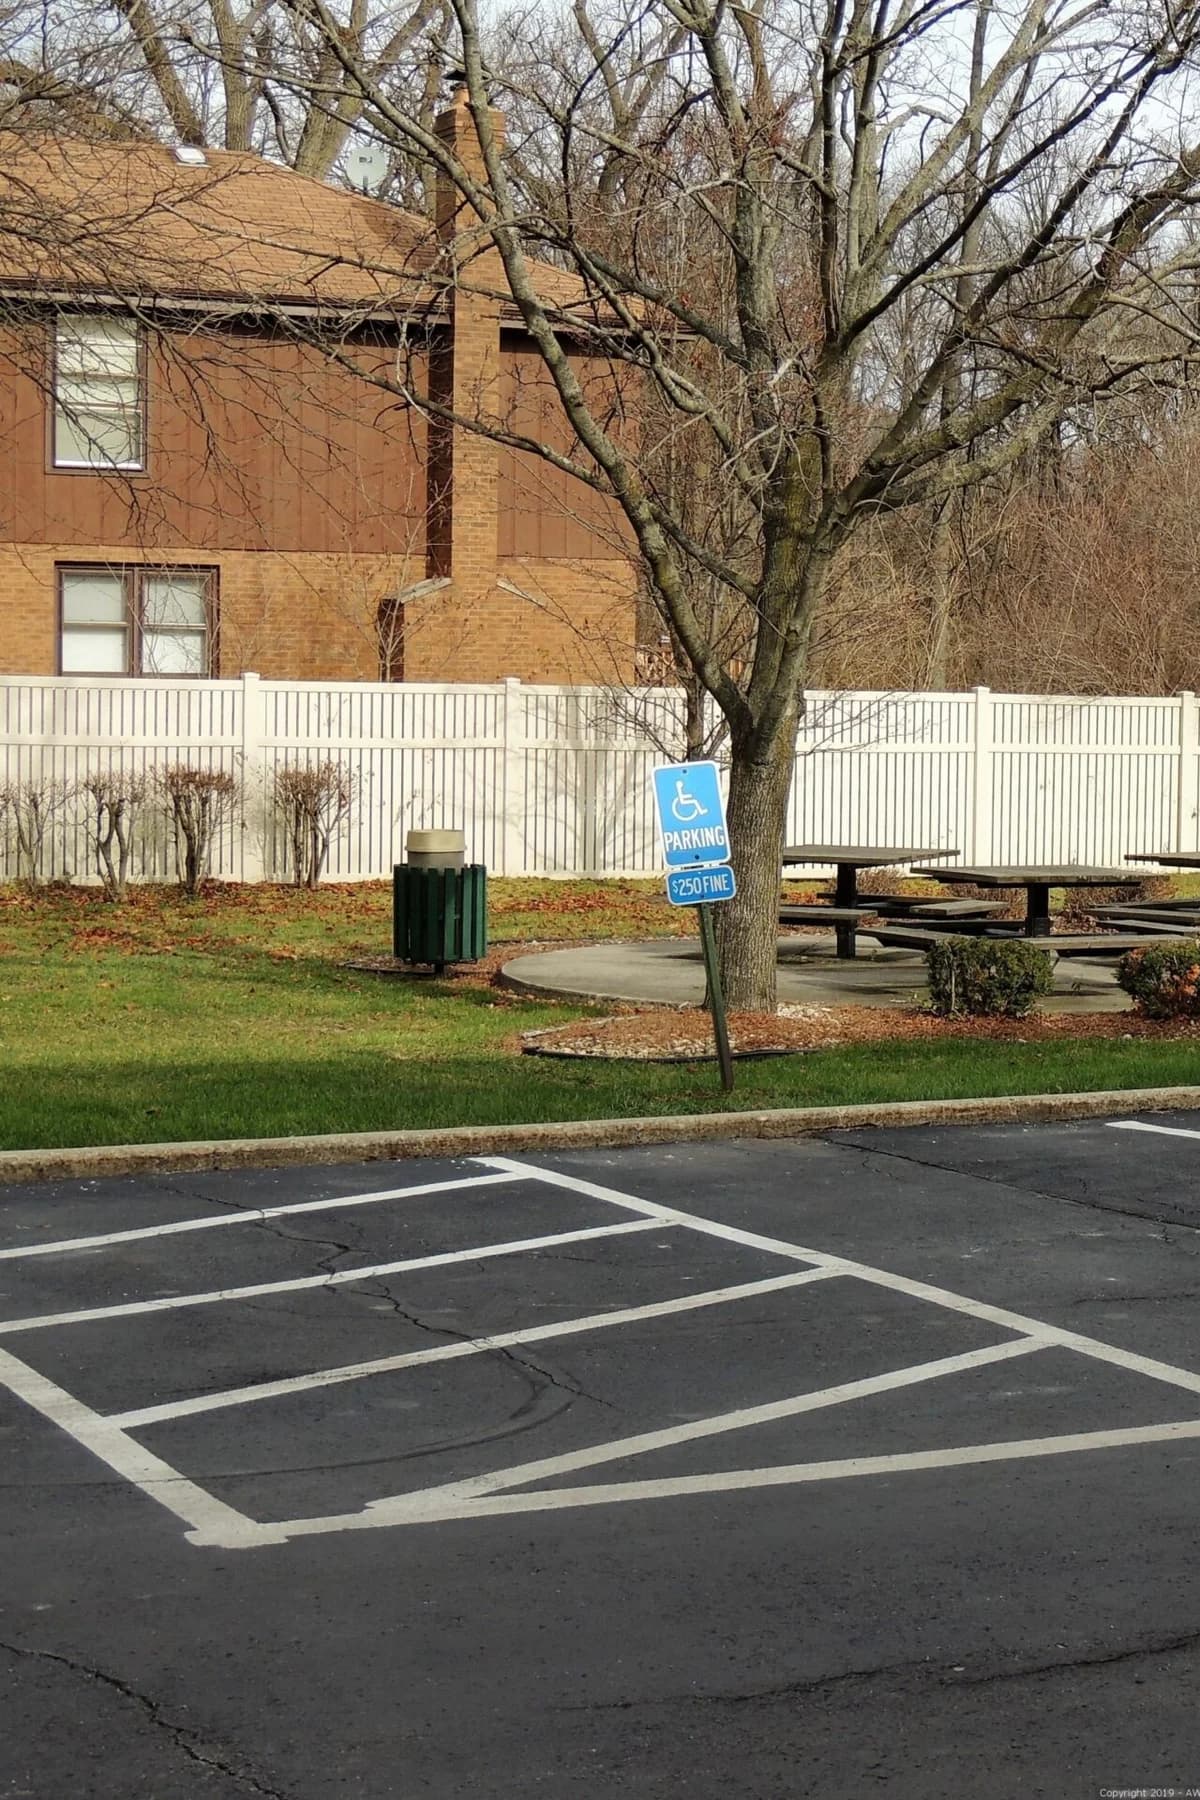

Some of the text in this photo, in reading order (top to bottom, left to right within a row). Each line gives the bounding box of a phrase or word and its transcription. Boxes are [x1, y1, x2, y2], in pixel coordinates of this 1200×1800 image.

[664, 826, 725, 852] PARKING
[672, 874, 730, 896] $250 FINE
